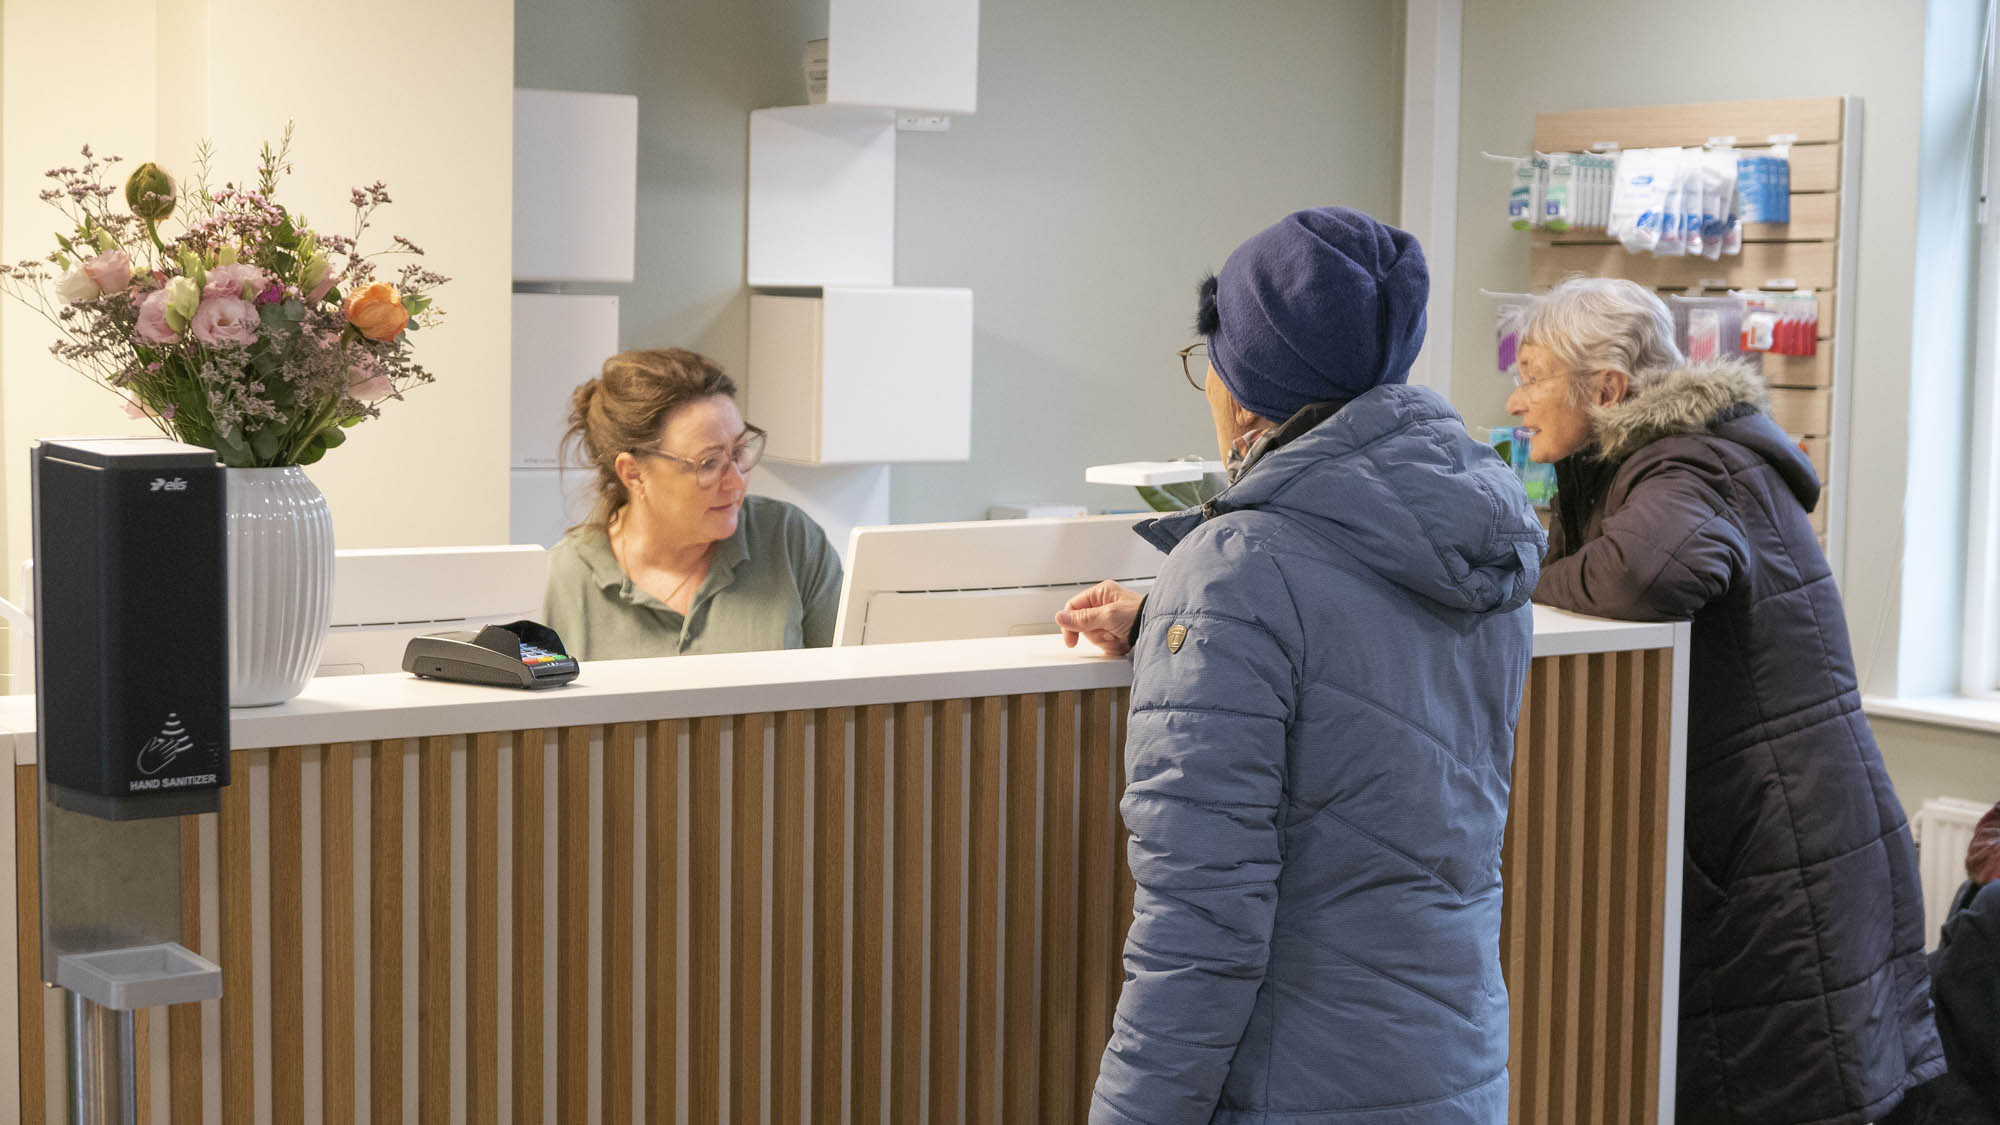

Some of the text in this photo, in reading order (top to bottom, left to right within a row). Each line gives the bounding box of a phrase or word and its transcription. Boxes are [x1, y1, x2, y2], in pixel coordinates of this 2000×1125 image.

[164, 477, 188, 490] elis
[129, 773, 217, 792] HAND SANITIZER
